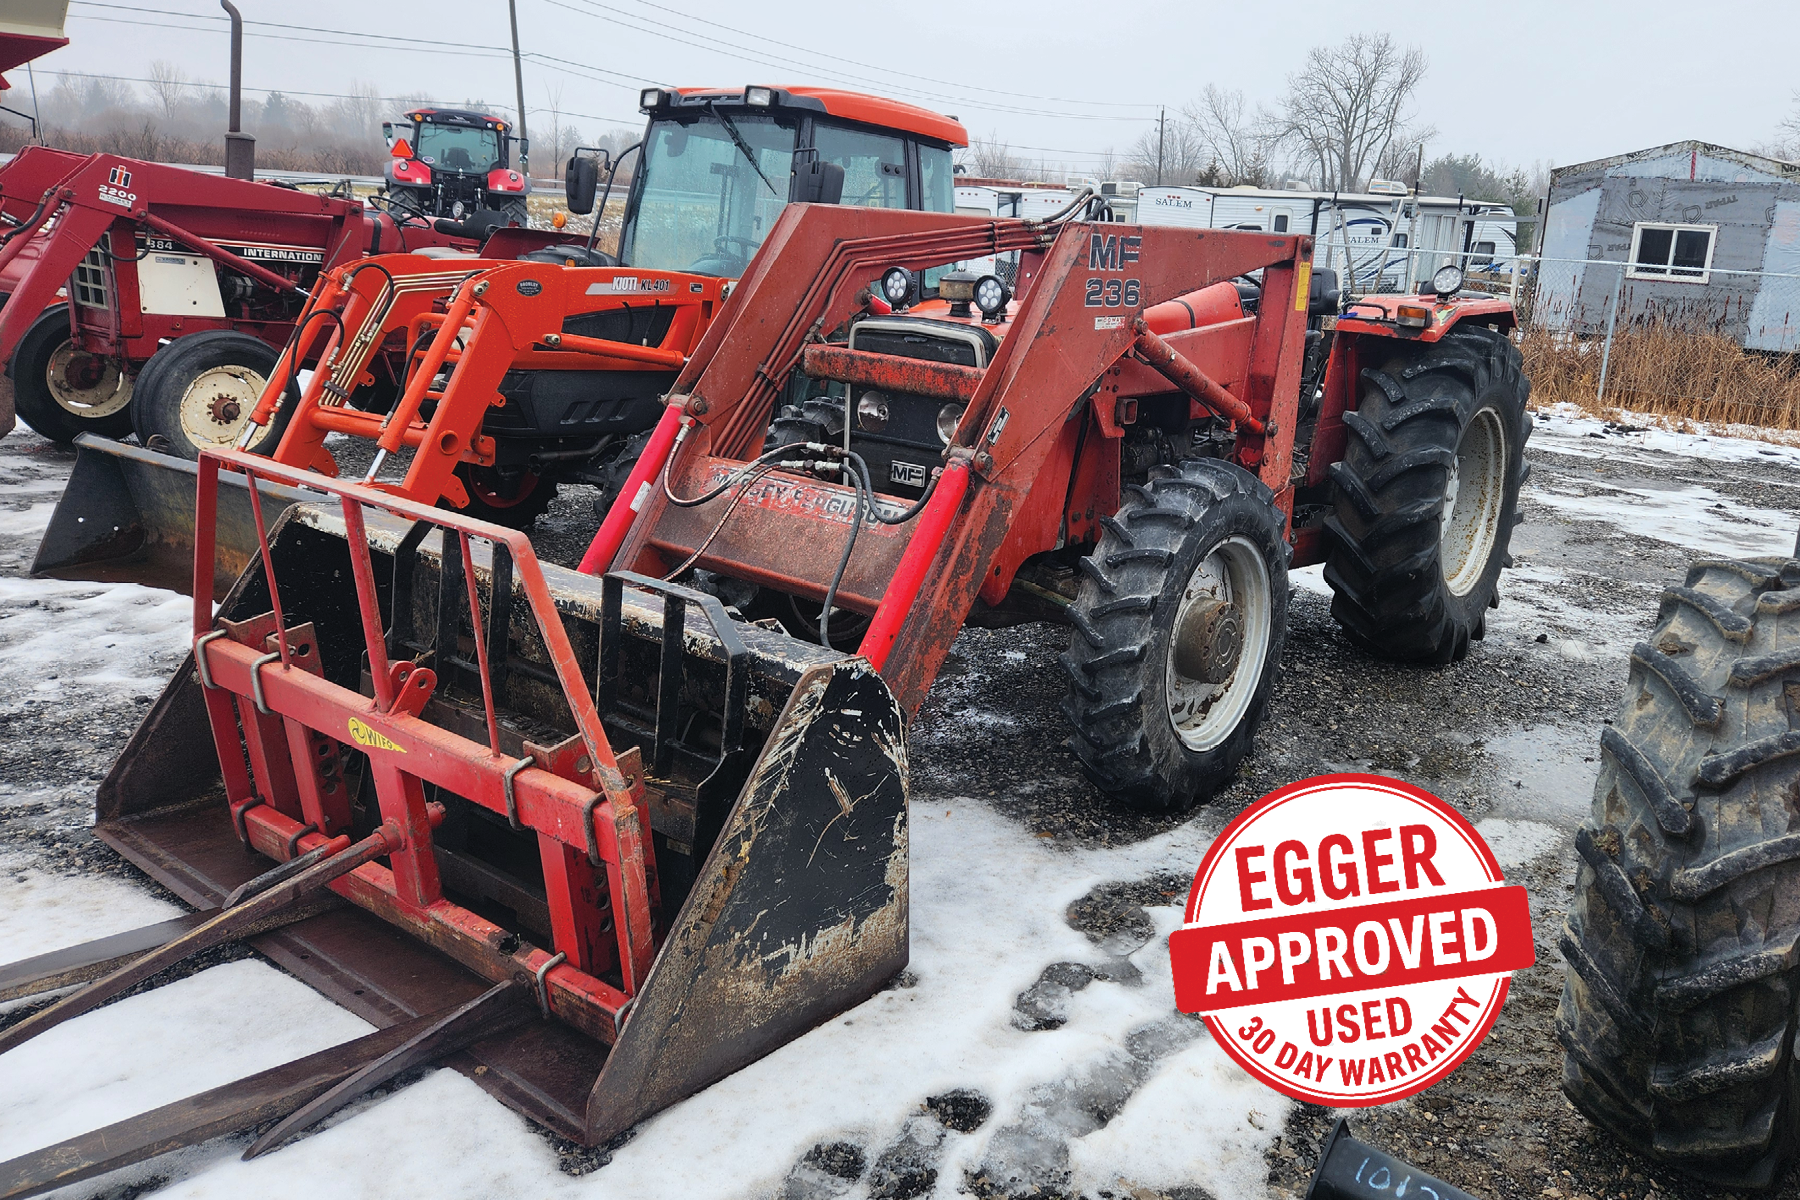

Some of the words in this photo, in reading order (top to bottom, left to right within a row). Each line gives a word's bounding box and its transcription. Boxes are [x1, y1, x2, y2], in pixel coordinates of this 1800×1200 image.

[98, 184, 137, 201] 2200
[1155, 198, 1192, 208] SALEM
[1705, 194, 1739, 209] TYPAR
[243, 248, 325, 262] INTERNATION
[1088, 233, 1142, 271] MF
[611, 276, 639, 291] KIOTI
[640, 279, 652, 291] KL
[653, 279, 671, 291] 401
[1084, 278, 1141, 308] 236
